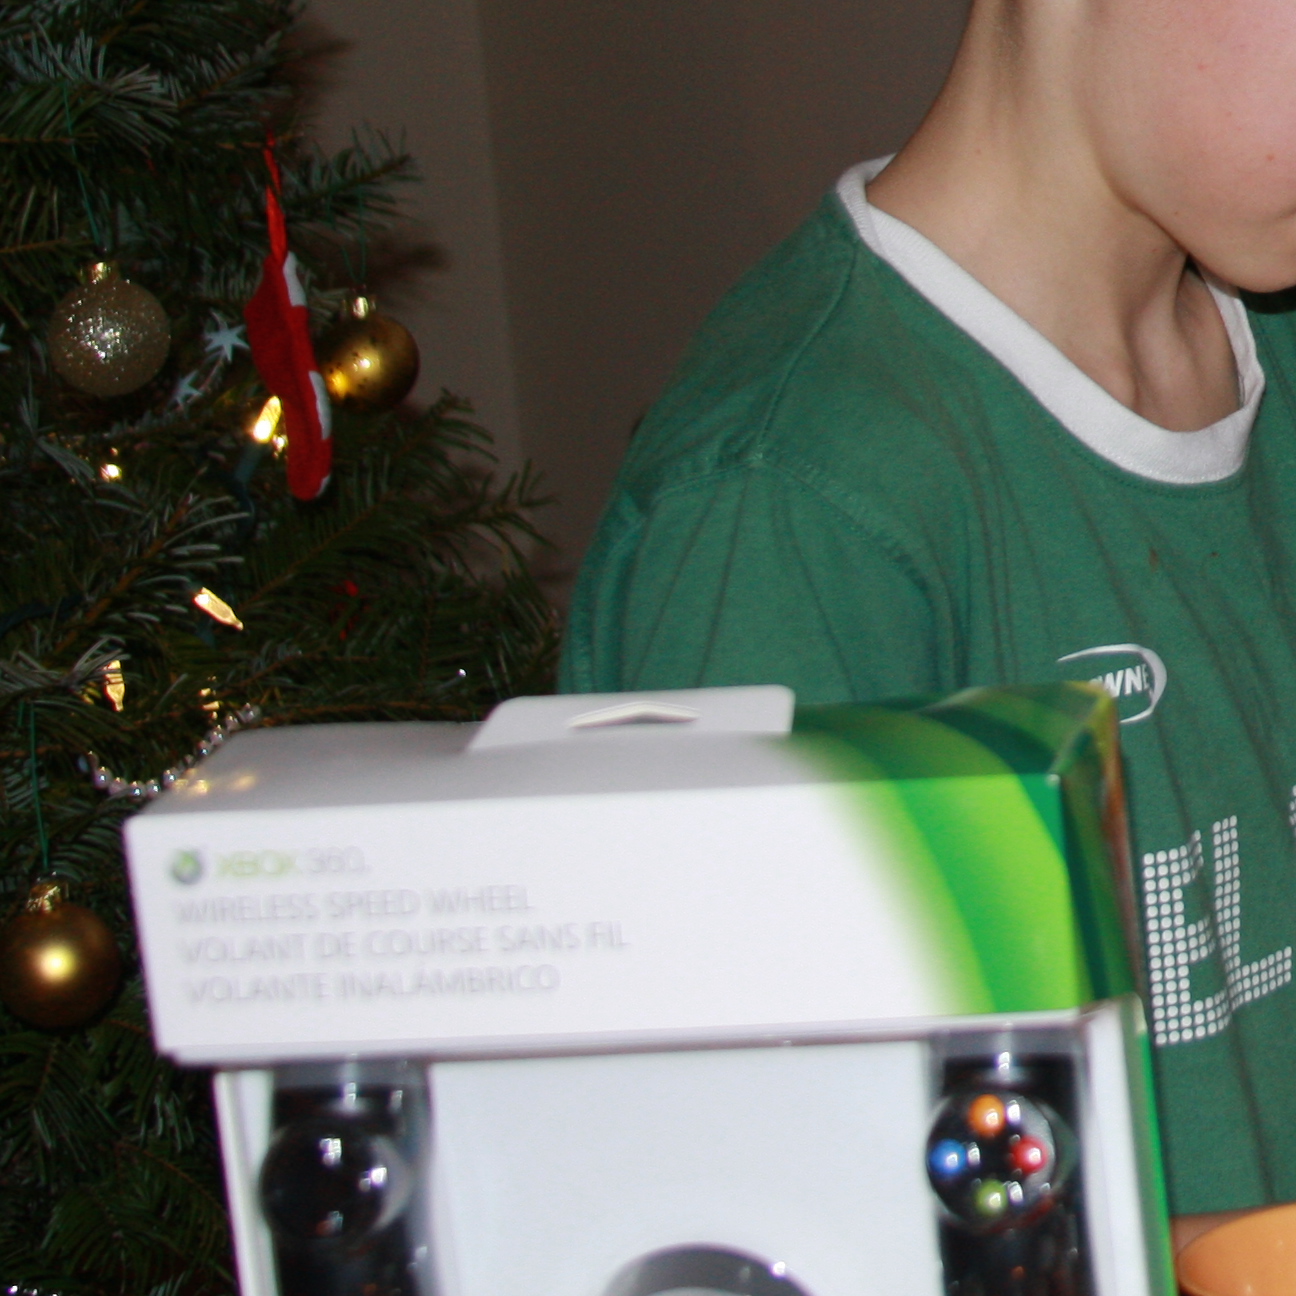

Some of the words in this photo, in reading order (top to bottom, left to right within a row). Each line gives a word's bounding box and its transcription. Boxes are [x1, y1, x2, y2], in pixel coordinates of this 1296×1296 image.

[218, 850, 301, 878] XBOX
[178, 892, 319, 924] WIRELESS
[323, 887, 421, 919] SPEED
[428, 883, 532, 915] WHEEL
[183, 932, 307, 965] VOLANT
[315, 930, 356, 959] DE
[361, 924, 489, 958] COURSE
[494, 920, 582, 953] SANS
[586, 919, 630, 948] FIL
[185, 972, 328, 1006] VOLANTE
